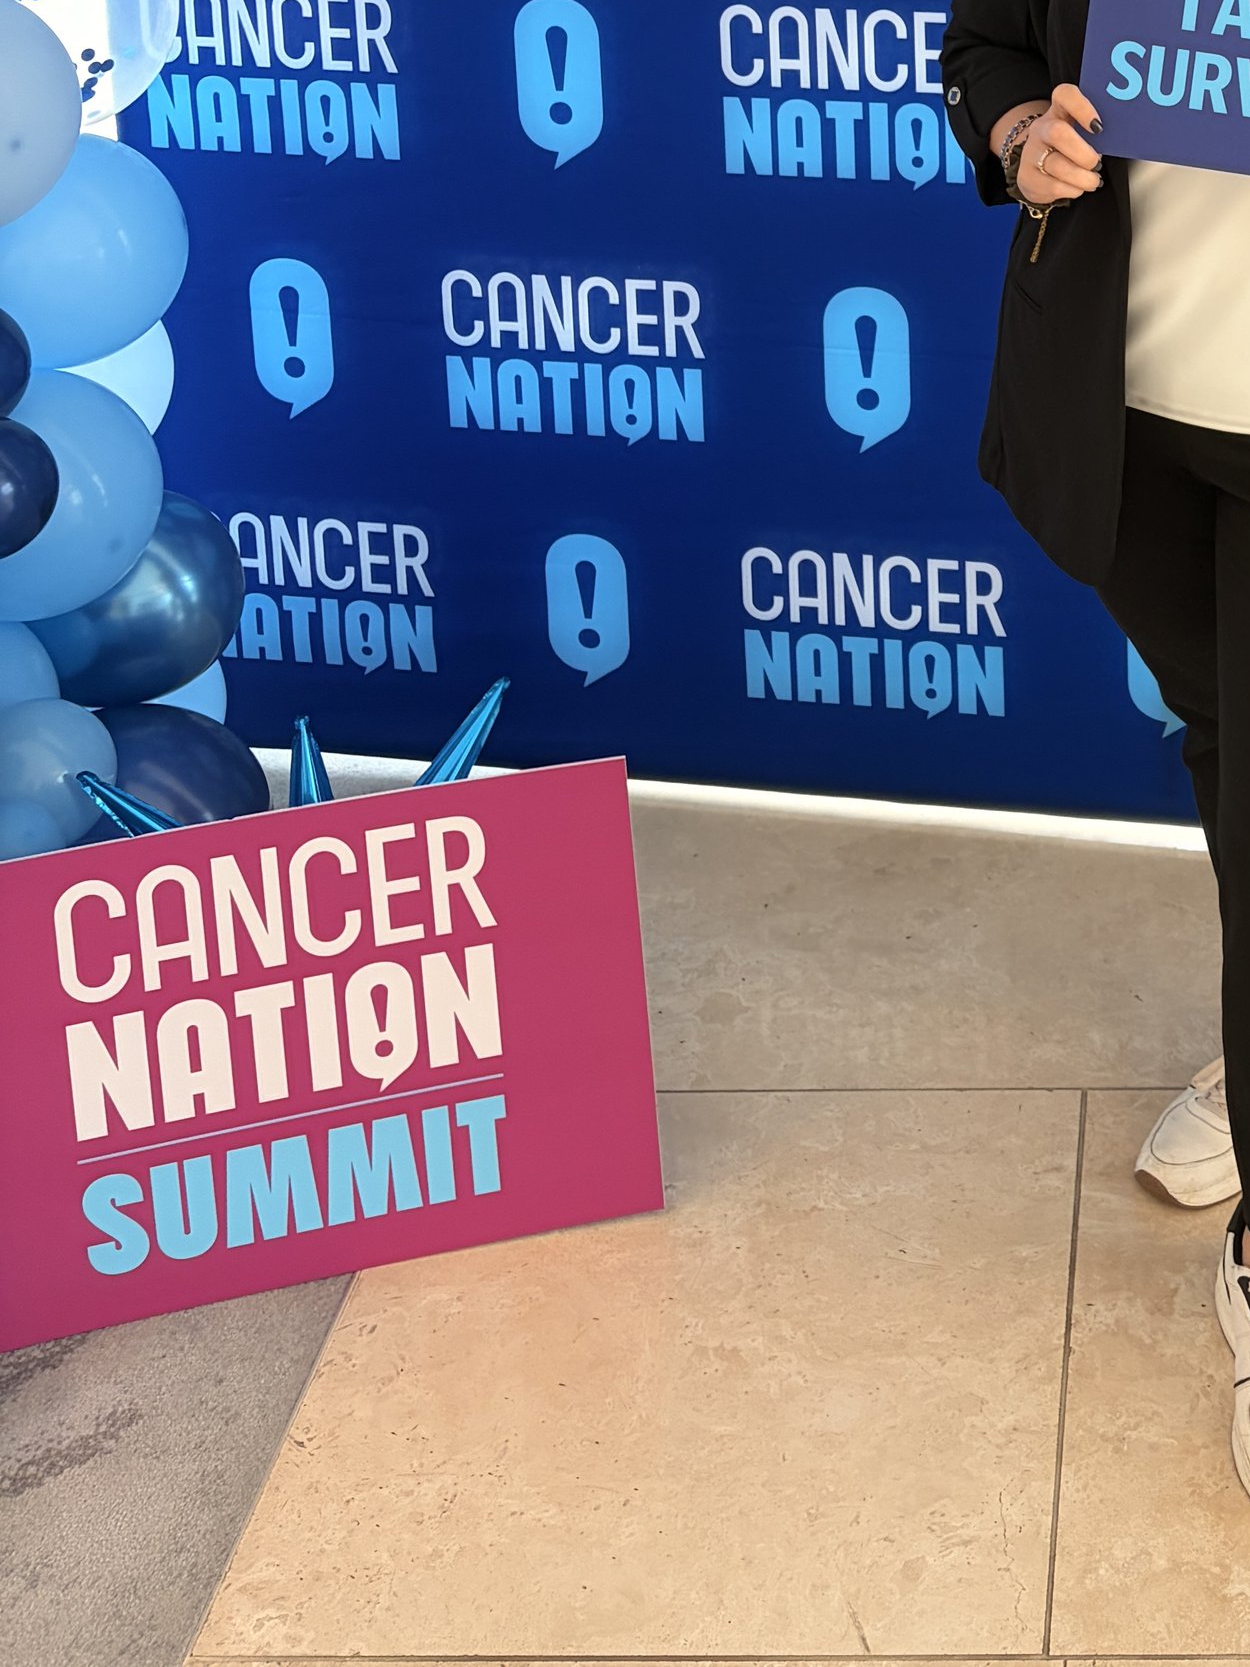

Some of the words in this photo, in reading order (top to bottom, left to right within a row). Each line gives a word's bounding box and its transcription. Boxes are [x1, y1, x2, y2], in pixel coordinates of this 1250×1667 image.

[719, 4, 947, 95] CANCE
[147, 74, 401, 166] NATION
[441, 269, 706, 359] CANCER
[445, 356, 705, 445] NATION
[228, 511, 435, 597] ANCER
[741, 546, 1007, 637] CANCER
[222, 592, 438, 676] ATION
[744, 630, 1005, 718] NATION
[54, 816, 497, 1003] CANCER
[66, 942, 503, 1143] NATION
[81, 1094, 507, 1275] SUMMIT
